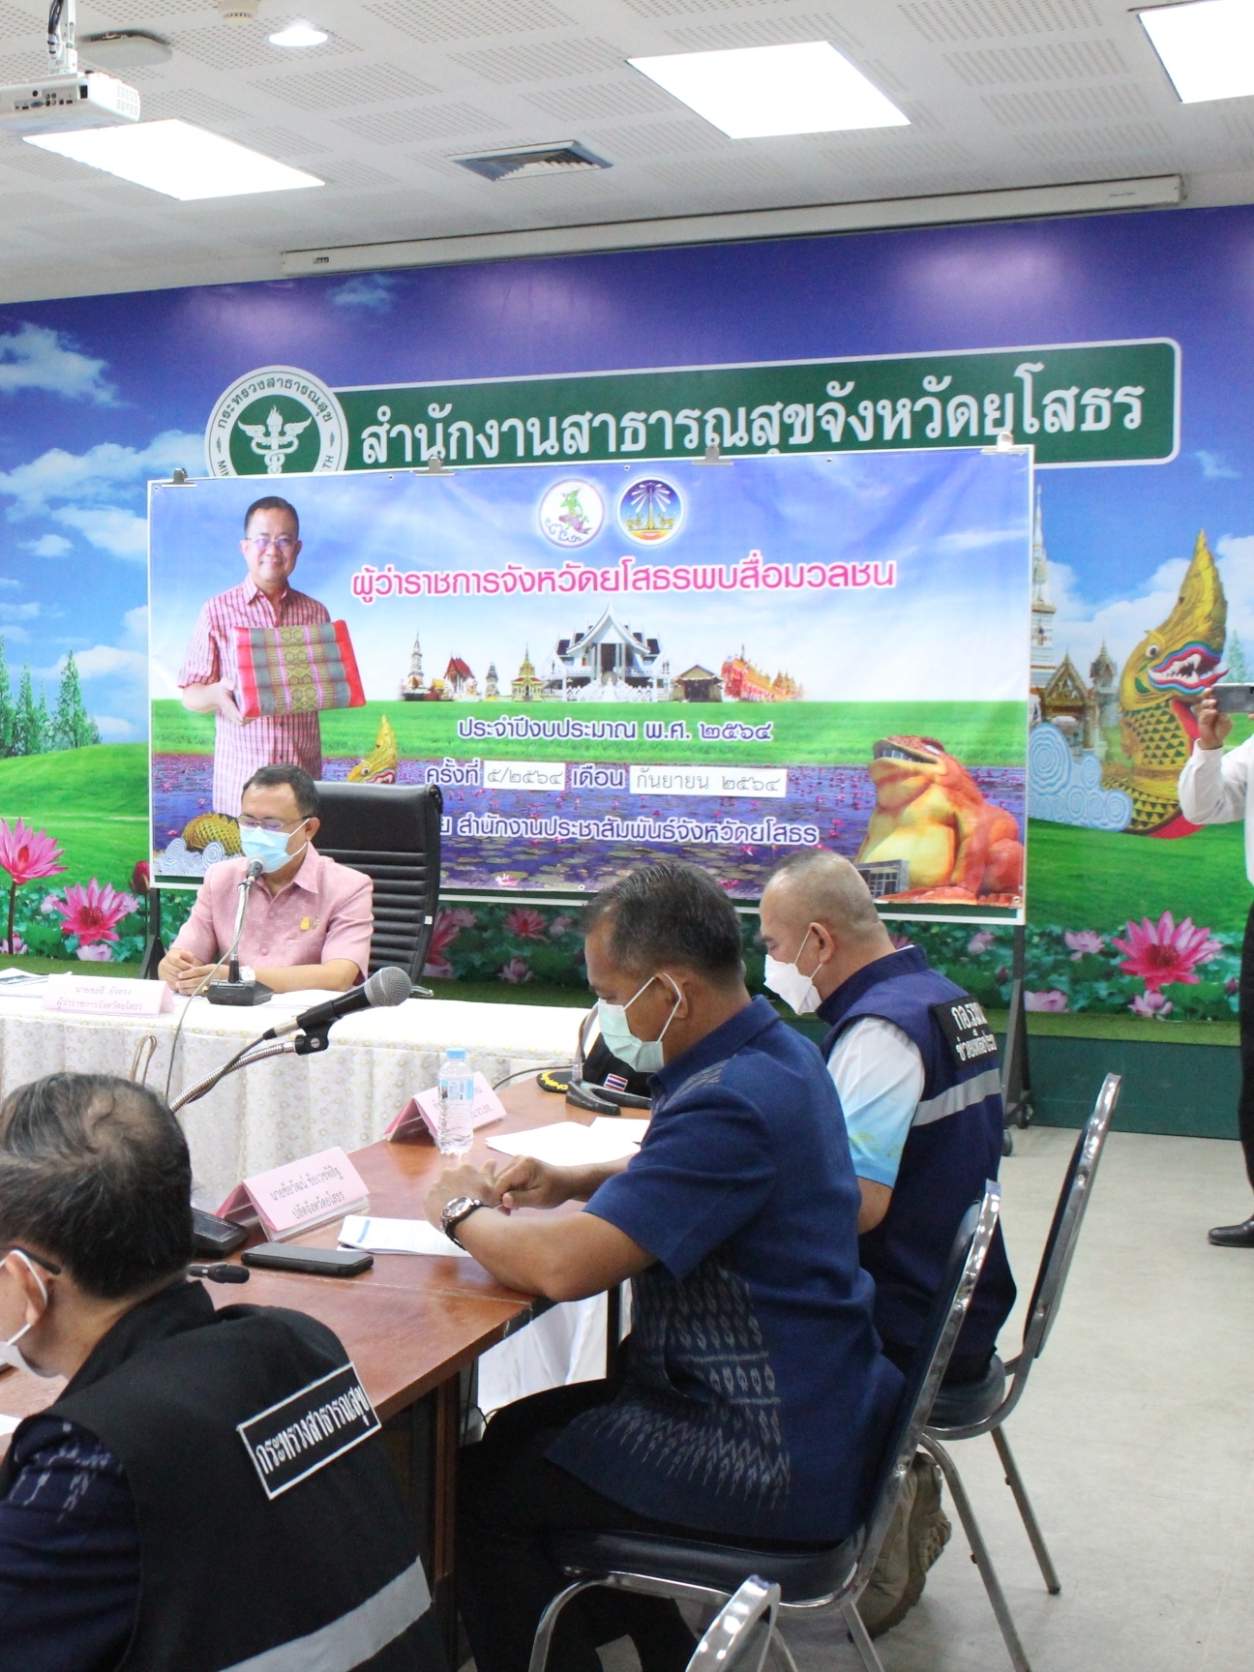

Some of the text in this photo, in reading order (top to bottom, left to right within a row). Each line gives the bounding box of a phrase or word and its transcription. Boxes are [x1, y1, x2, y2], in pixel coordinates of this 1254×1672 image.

[218, 377, 333, 429] กระทรวงสาธารณสุข
[352, 552, 895, 604] ผู้ว่าราชการจังหวัดยโสธรพบสื่อมวลชน
[458, 716, 773, 741] ประจำปีงบประมาณ พ.ศ. ๒๕๖๔
[426, 757, 781, 792] ครั้งที่ ๕/๒๕๖๔ เดือน กันยายน ๒๕๖๔
[457, 812, 819, 846] สำนักงานประชาสัมพันธ์จังหวัดยโสธร
[254, 1385, 370, 1475] กระทรวงสาธารณสุข
